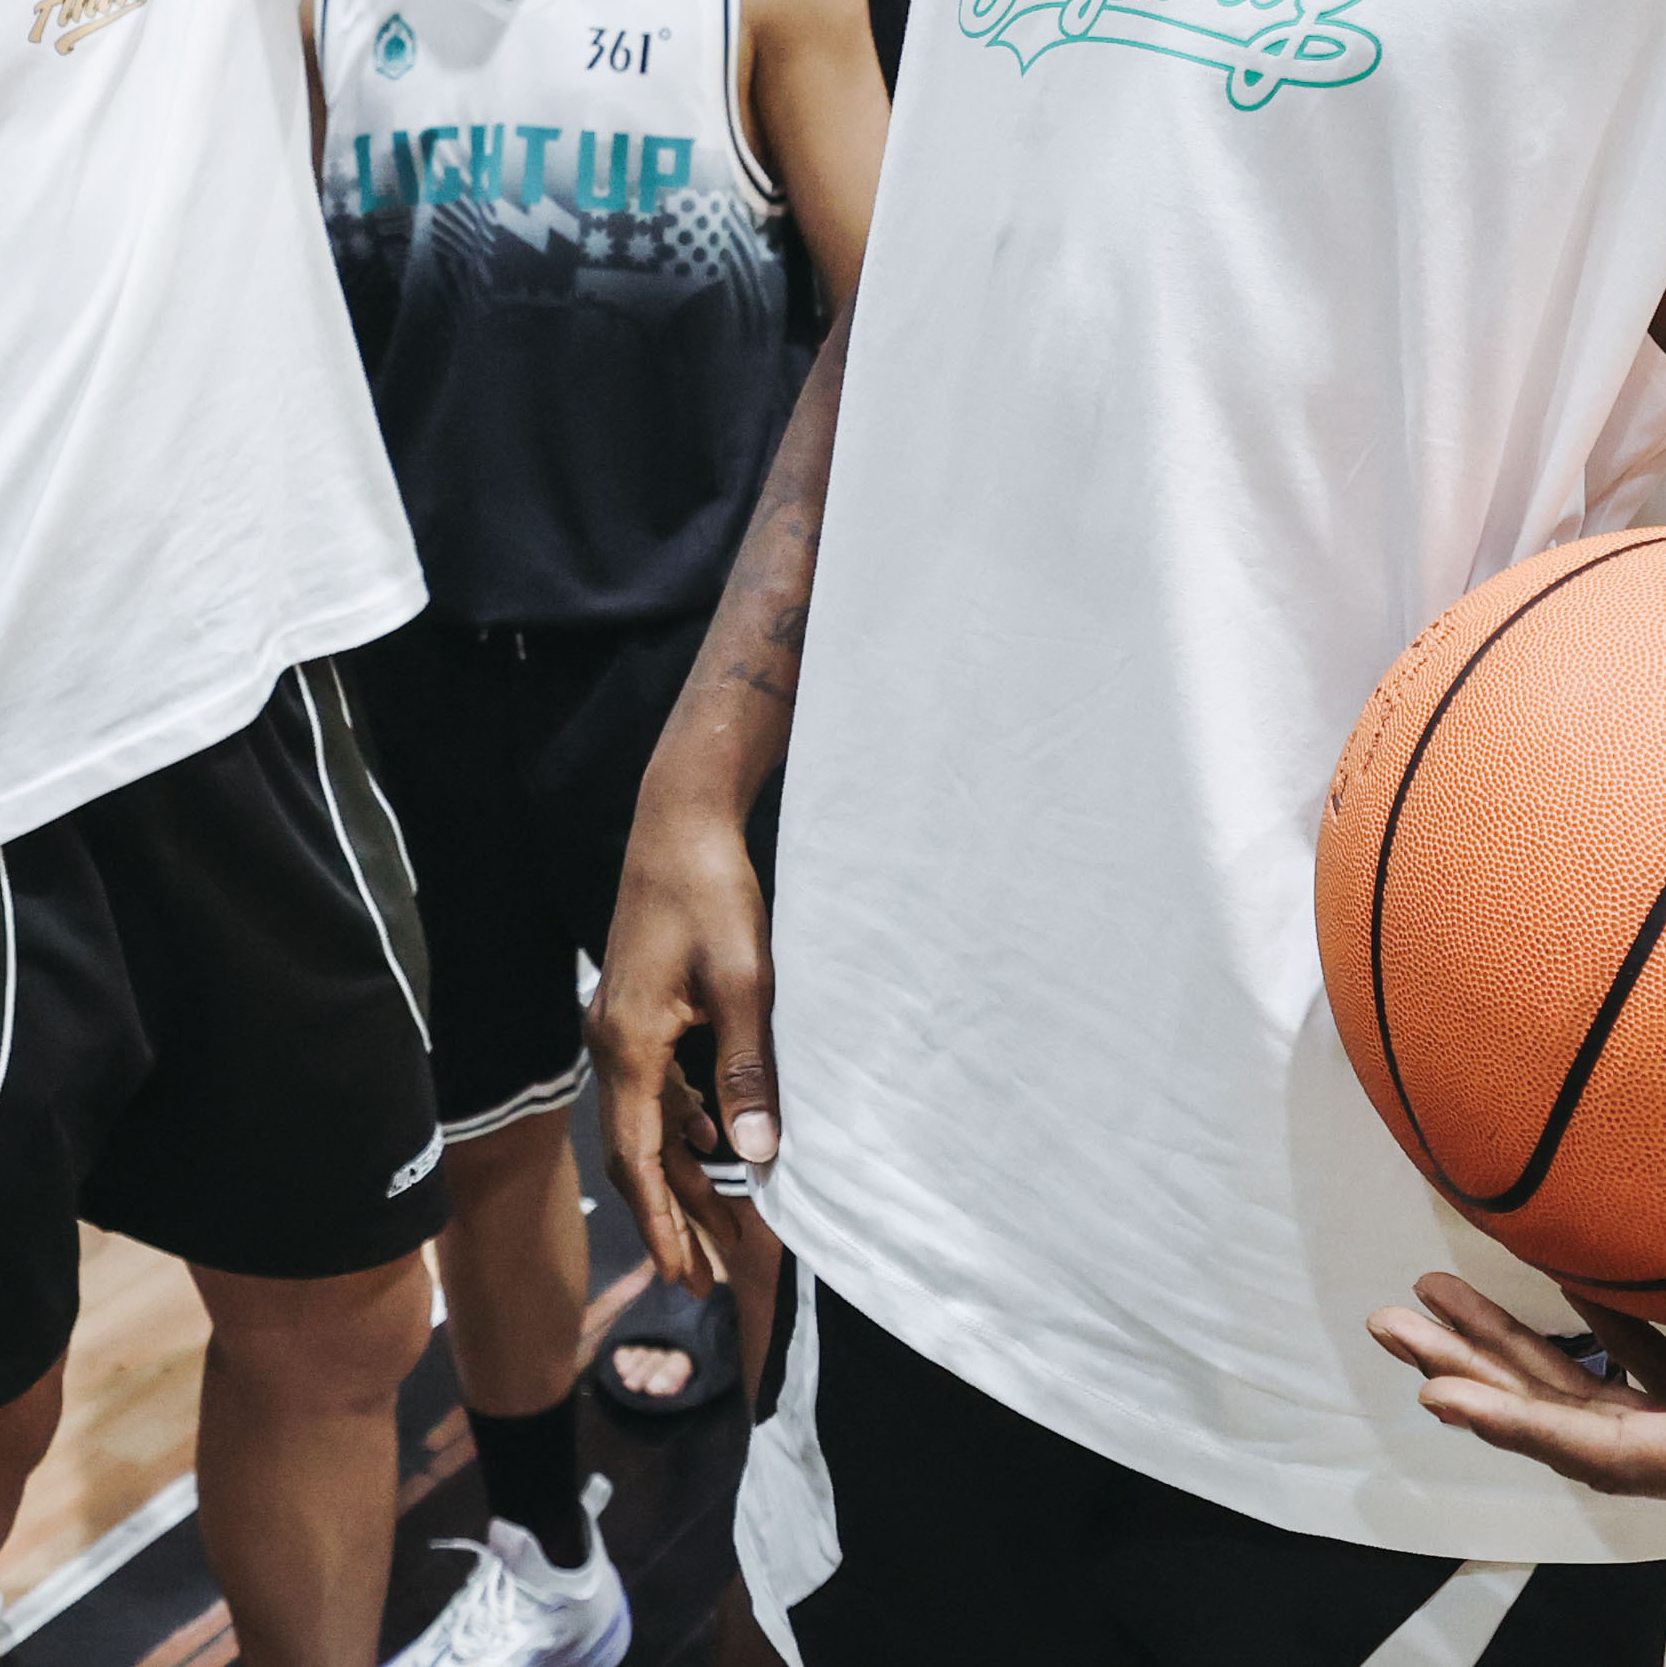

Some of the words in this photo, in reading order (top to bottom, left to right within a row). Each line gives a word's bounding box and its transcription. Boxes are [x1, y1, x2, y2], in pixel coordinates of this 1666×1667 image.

[586, 27, 672, 74] 361°
[354, 122, 563, 214] LIGHT
[575, 130, 695, 214] UP
